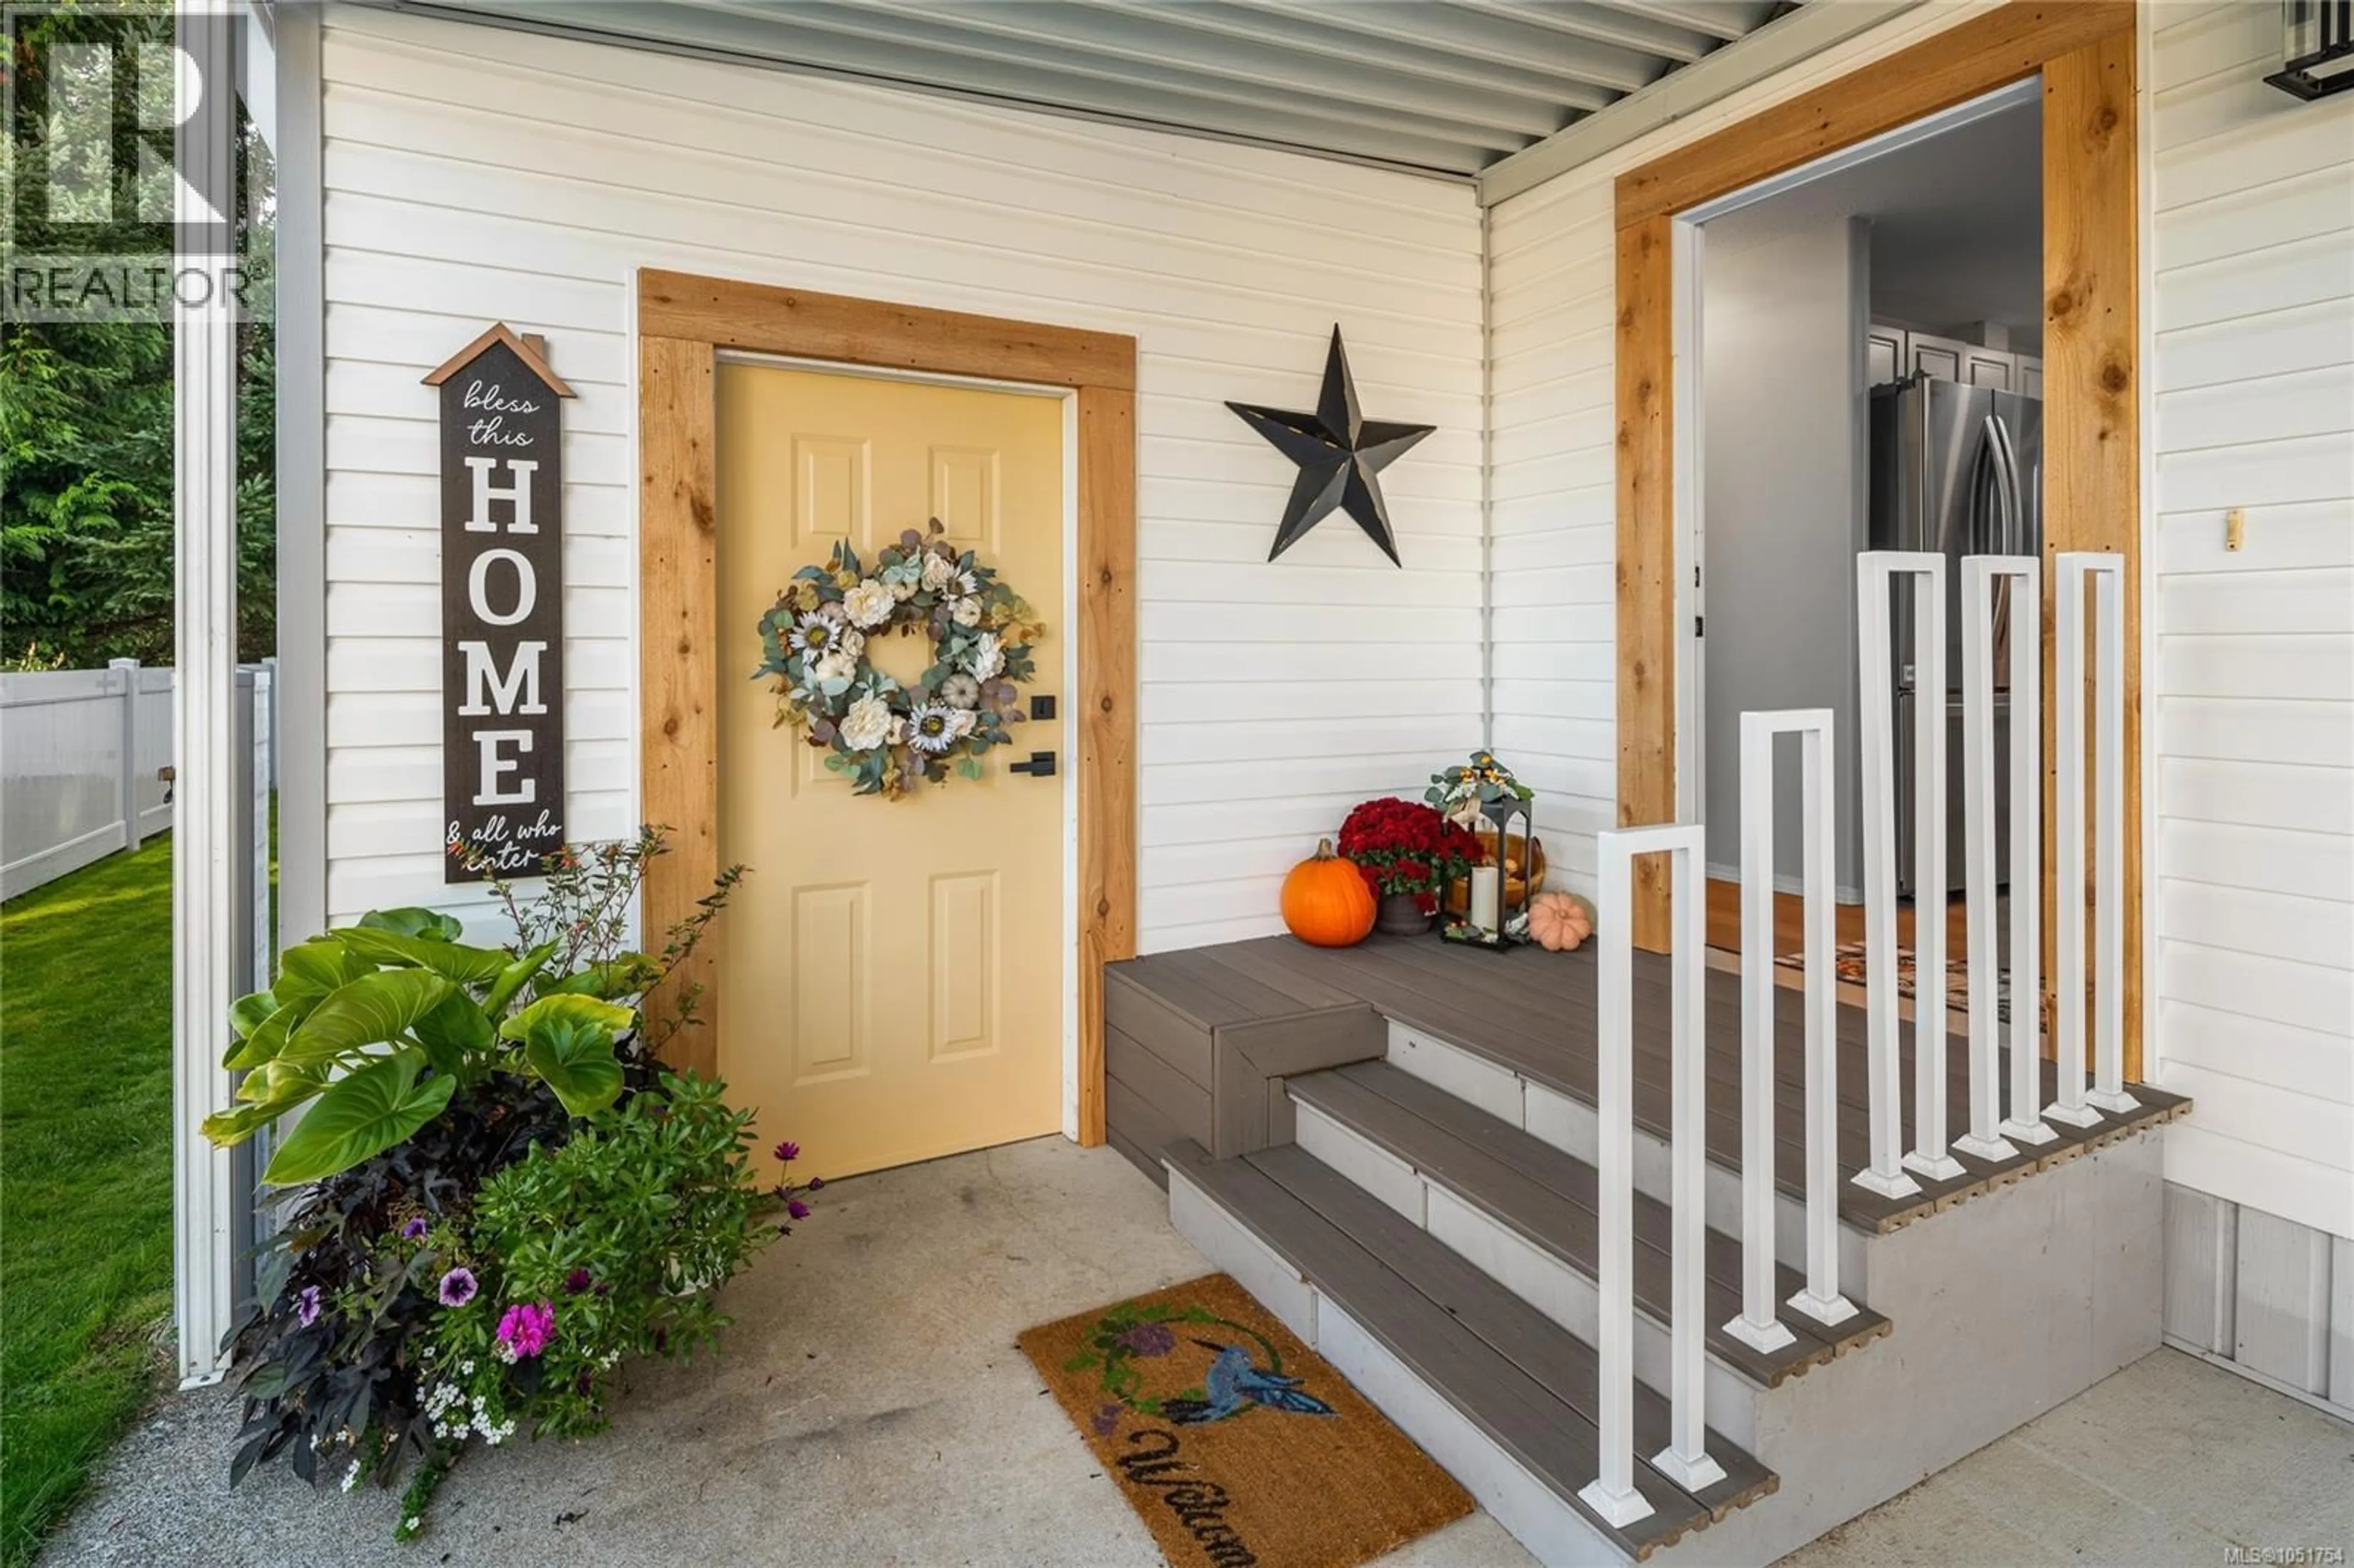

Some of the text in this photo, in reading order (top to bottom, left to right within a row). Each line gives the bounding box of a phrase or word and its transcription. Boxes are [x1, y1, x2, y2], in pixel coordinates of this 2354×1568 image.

[463, 379, 540, 413] bless
[467, 416, 534, 446] this
[458, 457, 547, 807] HOME
[446, 809, 562, 844] & all who
